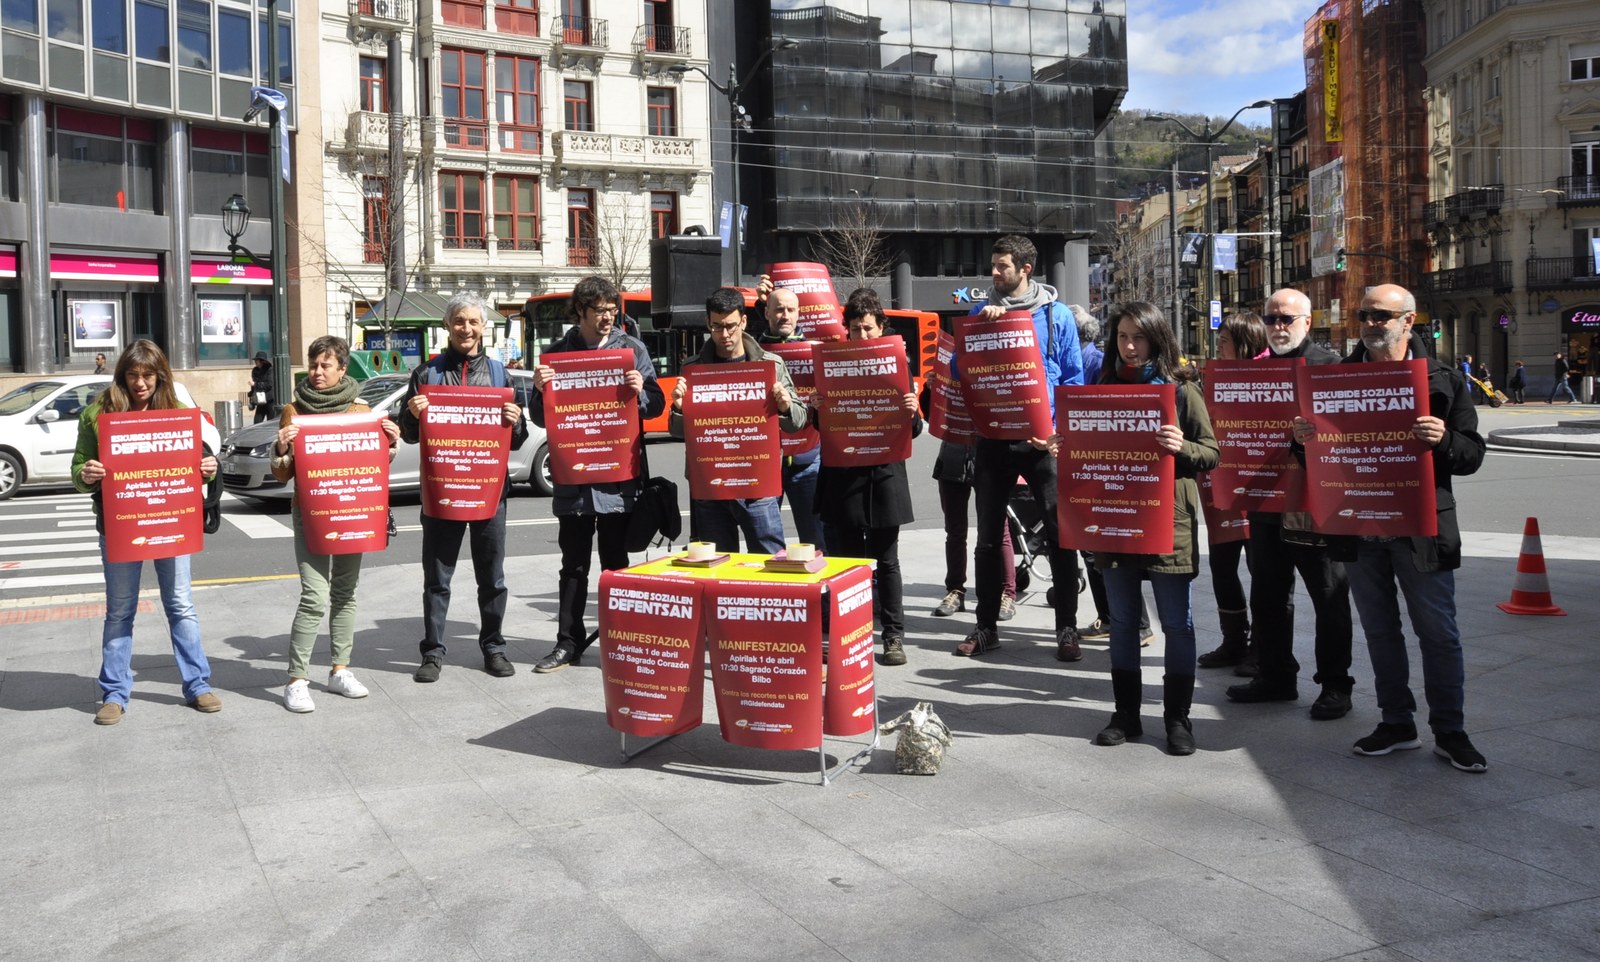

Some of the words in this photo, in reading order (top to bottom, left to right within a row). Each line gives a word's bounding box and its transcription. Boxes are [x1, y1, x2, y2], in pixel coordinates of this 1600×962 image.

[965, 333, 997, 341] ESKUBIDE
[999, 330, 1032, 338] SOZIALEN
[371, 339, 416, 349] DECTHLON
[965, 337, 1034, 352] DEFENTSAN
[824, 360, 858, 369] ESKUBIDE
[859, 356, 896, 366] SOZIALEN
[968, 361, 1036, 374] MANIFESTAZIOA
[587, 368, 623, 377] SOZIALEN
[824, 364, 897, 377] DEFENTSAN
[552, 376, 624, 390] DEFENTSAN
[693, 390, 766, 403] DEFENTSAN
[1214, 390, 1294, 402] DEFENTSAN
[1313, 390, 1360, 400] ESKUBIDE
[1362, 387, 1413, 397] SOZIALEN
[555, 401, 626, 413] MANIFESTAZIOA
[1313, 396, 1414, 413] DEFENTSAN
[427, 414, 501, 425] DEFENTSAN
[694, 416, 766, 426] MANIFESTAZIOA
[1069, 420, 1161, 431] DEFENTSAN
[111, 433, 151, 442] ESKUBIDE
[152, 431, 193, 440] SOZIALEN
[1318, 431, 1415, 442] MANIFESTAZIOA
[111, 438, 193, 454] DEFENTSAN
[428, 439, 500, 448] MANIFESTAZIOA
[1071, 450, 1159, 460] MANIFESTAZIOA
[1342, 456, 1377, 464] Sagrado
[114, 466, 193, 481] MANIFESTAZIOA
[1093, 474, 1124, 482] Sagrado
[125, 482, 152, 491] Apirilak
[136, 489, 165, 498] Sagrado
[610, 588, 649, 600] ESKUBIDE
[650, 592, 693, 605] SOZIALEN
[717, 597, 759, 606] ESKUBIDE
[761, 598, 806, 607] SOZIALEN
[609, 597, 692, 618] DEFENTSAN
[717, 606, 806, 621] DEFENTSAN
[608, 630, 690, 648] MANIFESTAZIOA
[617, 646, 643, 656] Apirilak
[719, 640, 806, 653] MANIFESTAZIOA
[609, 653, 625, 661] 17:30
[626, 656, 655, 667] Sagrado
[657, 659, 689, 669] Corazón
[730, 655, 757, 664] Apirilak
[740, 666, 771, 675] Sagrado
[608, 676, 624, 686] Contra
